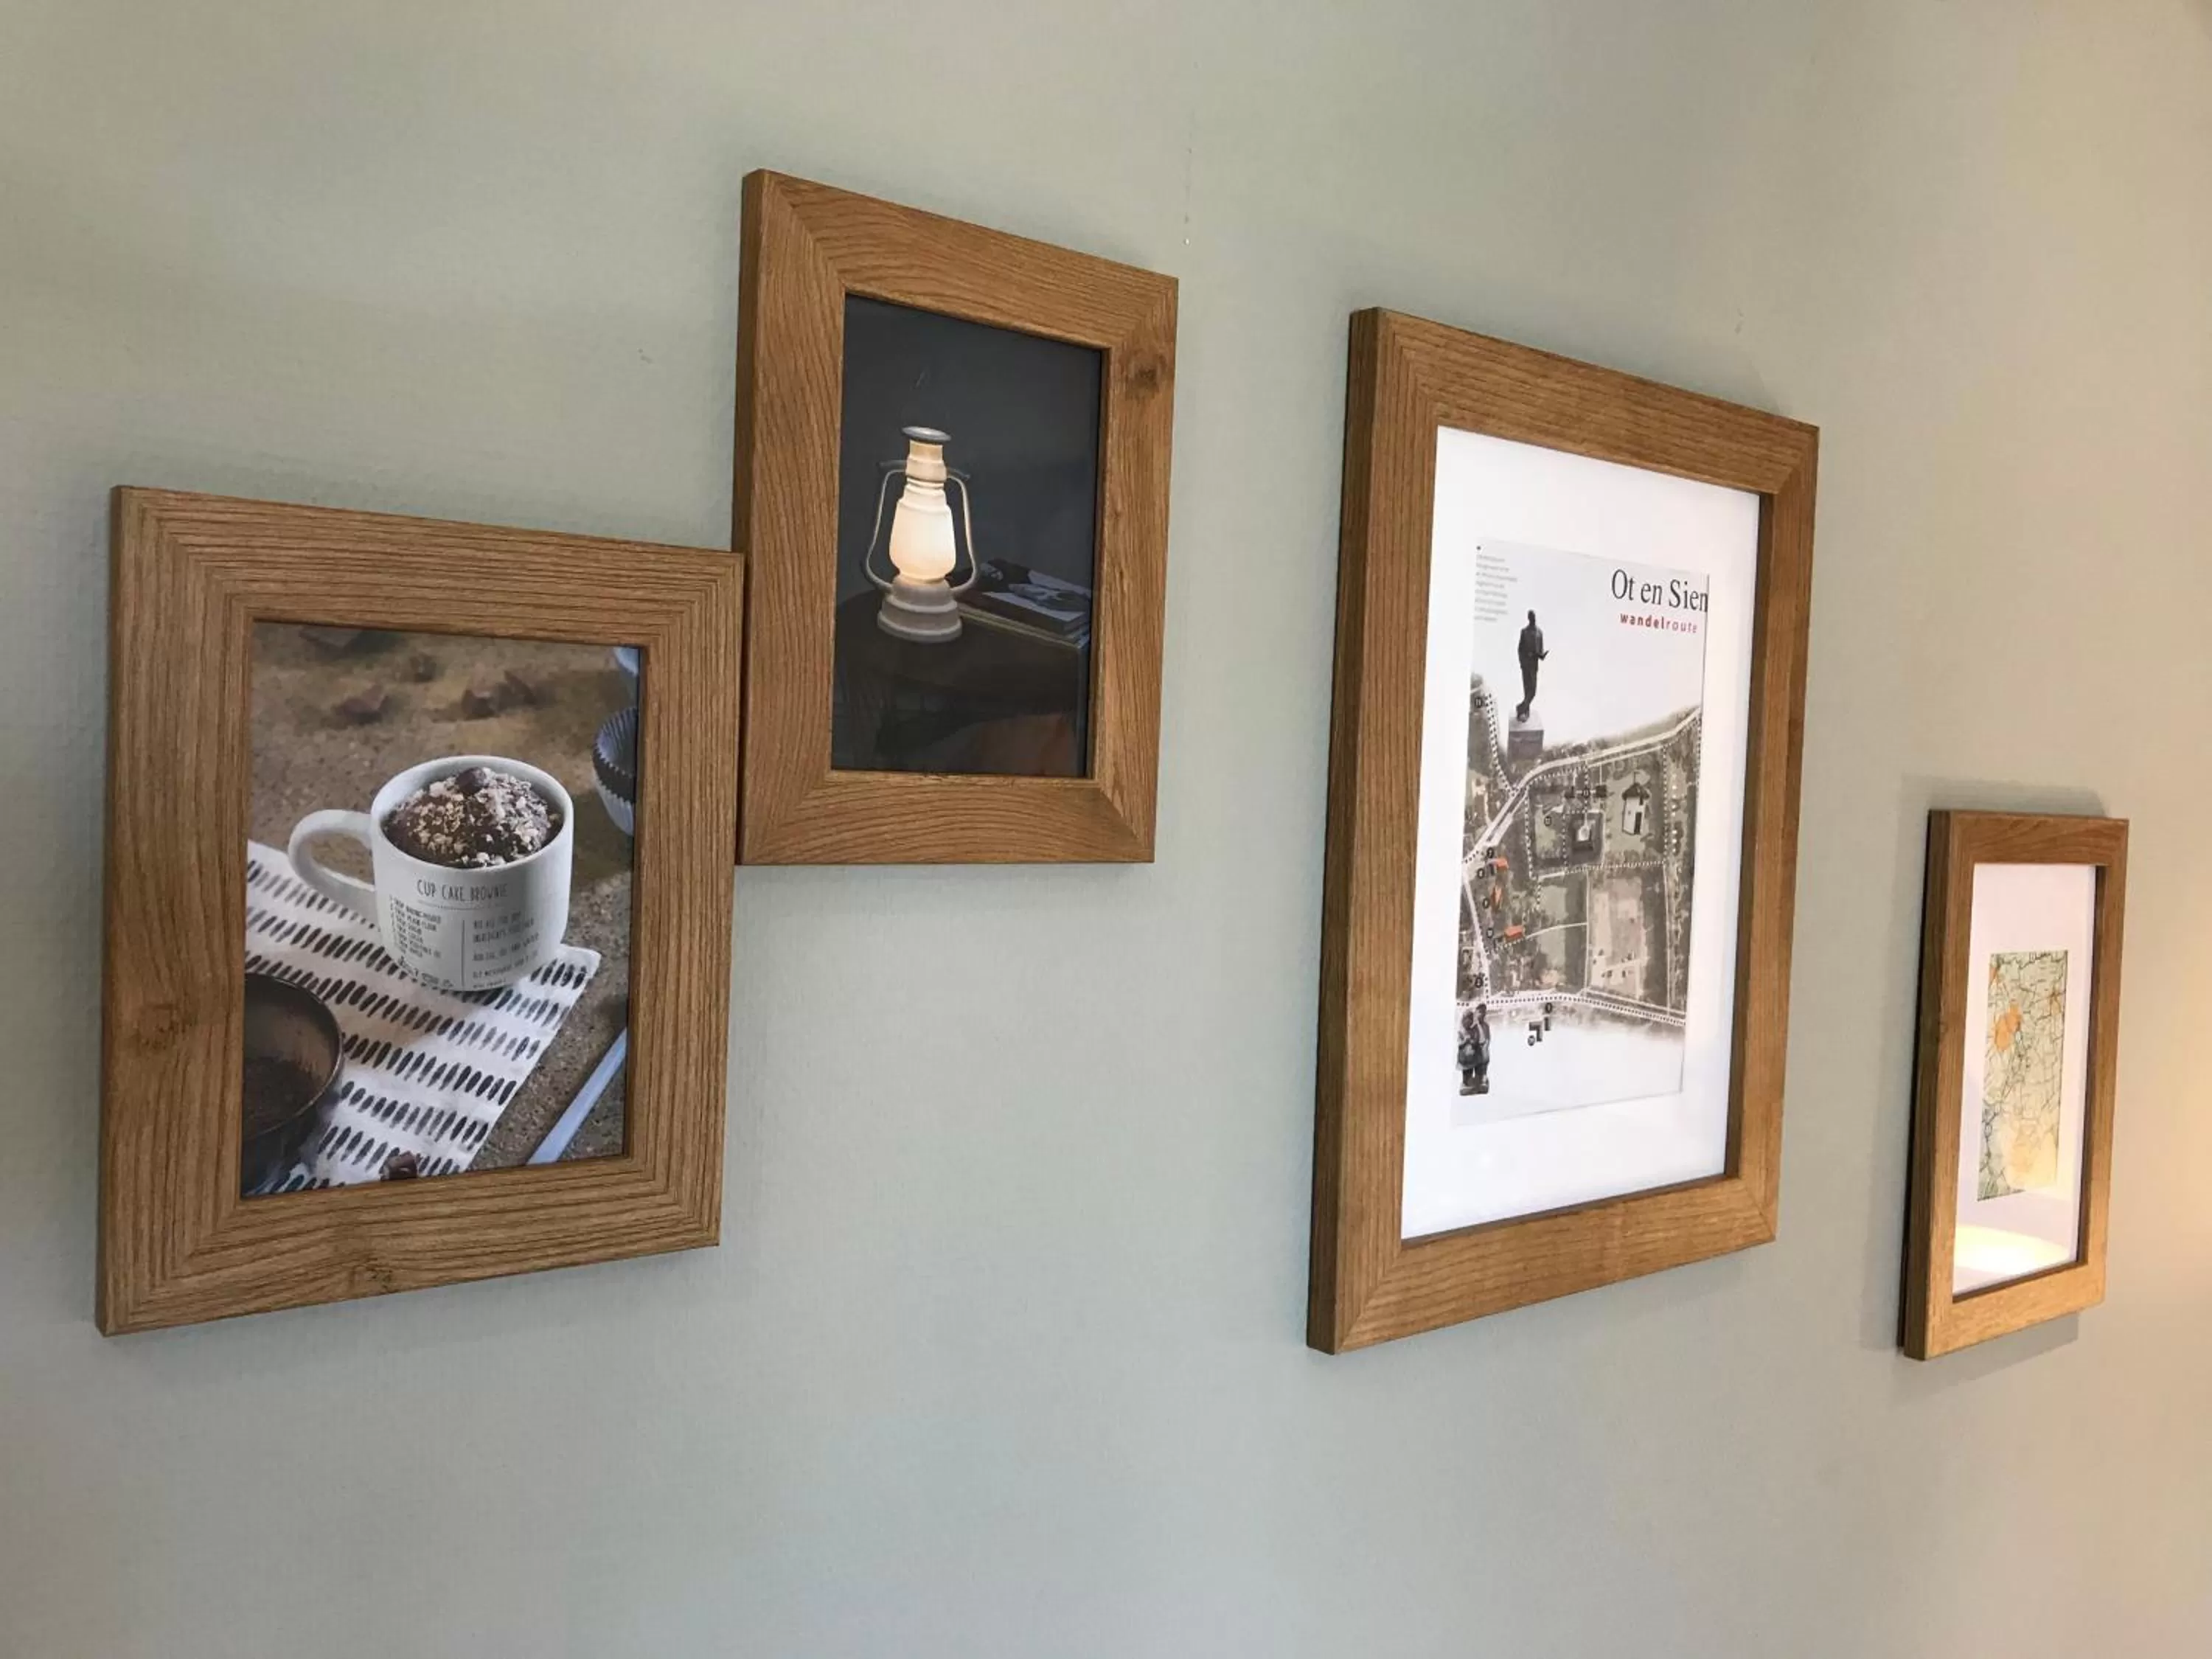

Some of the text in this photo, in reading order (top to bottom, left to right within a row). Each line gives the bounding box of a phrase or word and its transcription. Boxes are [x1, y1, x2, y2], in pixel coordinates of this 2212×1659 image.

[1612, 568, 1708, 613] Ot en Sien
[1620, 613, 1697, 633] wandelroute
[417, 879, 436, 897] CUP
[442, 885, 463, 901] CAKE
